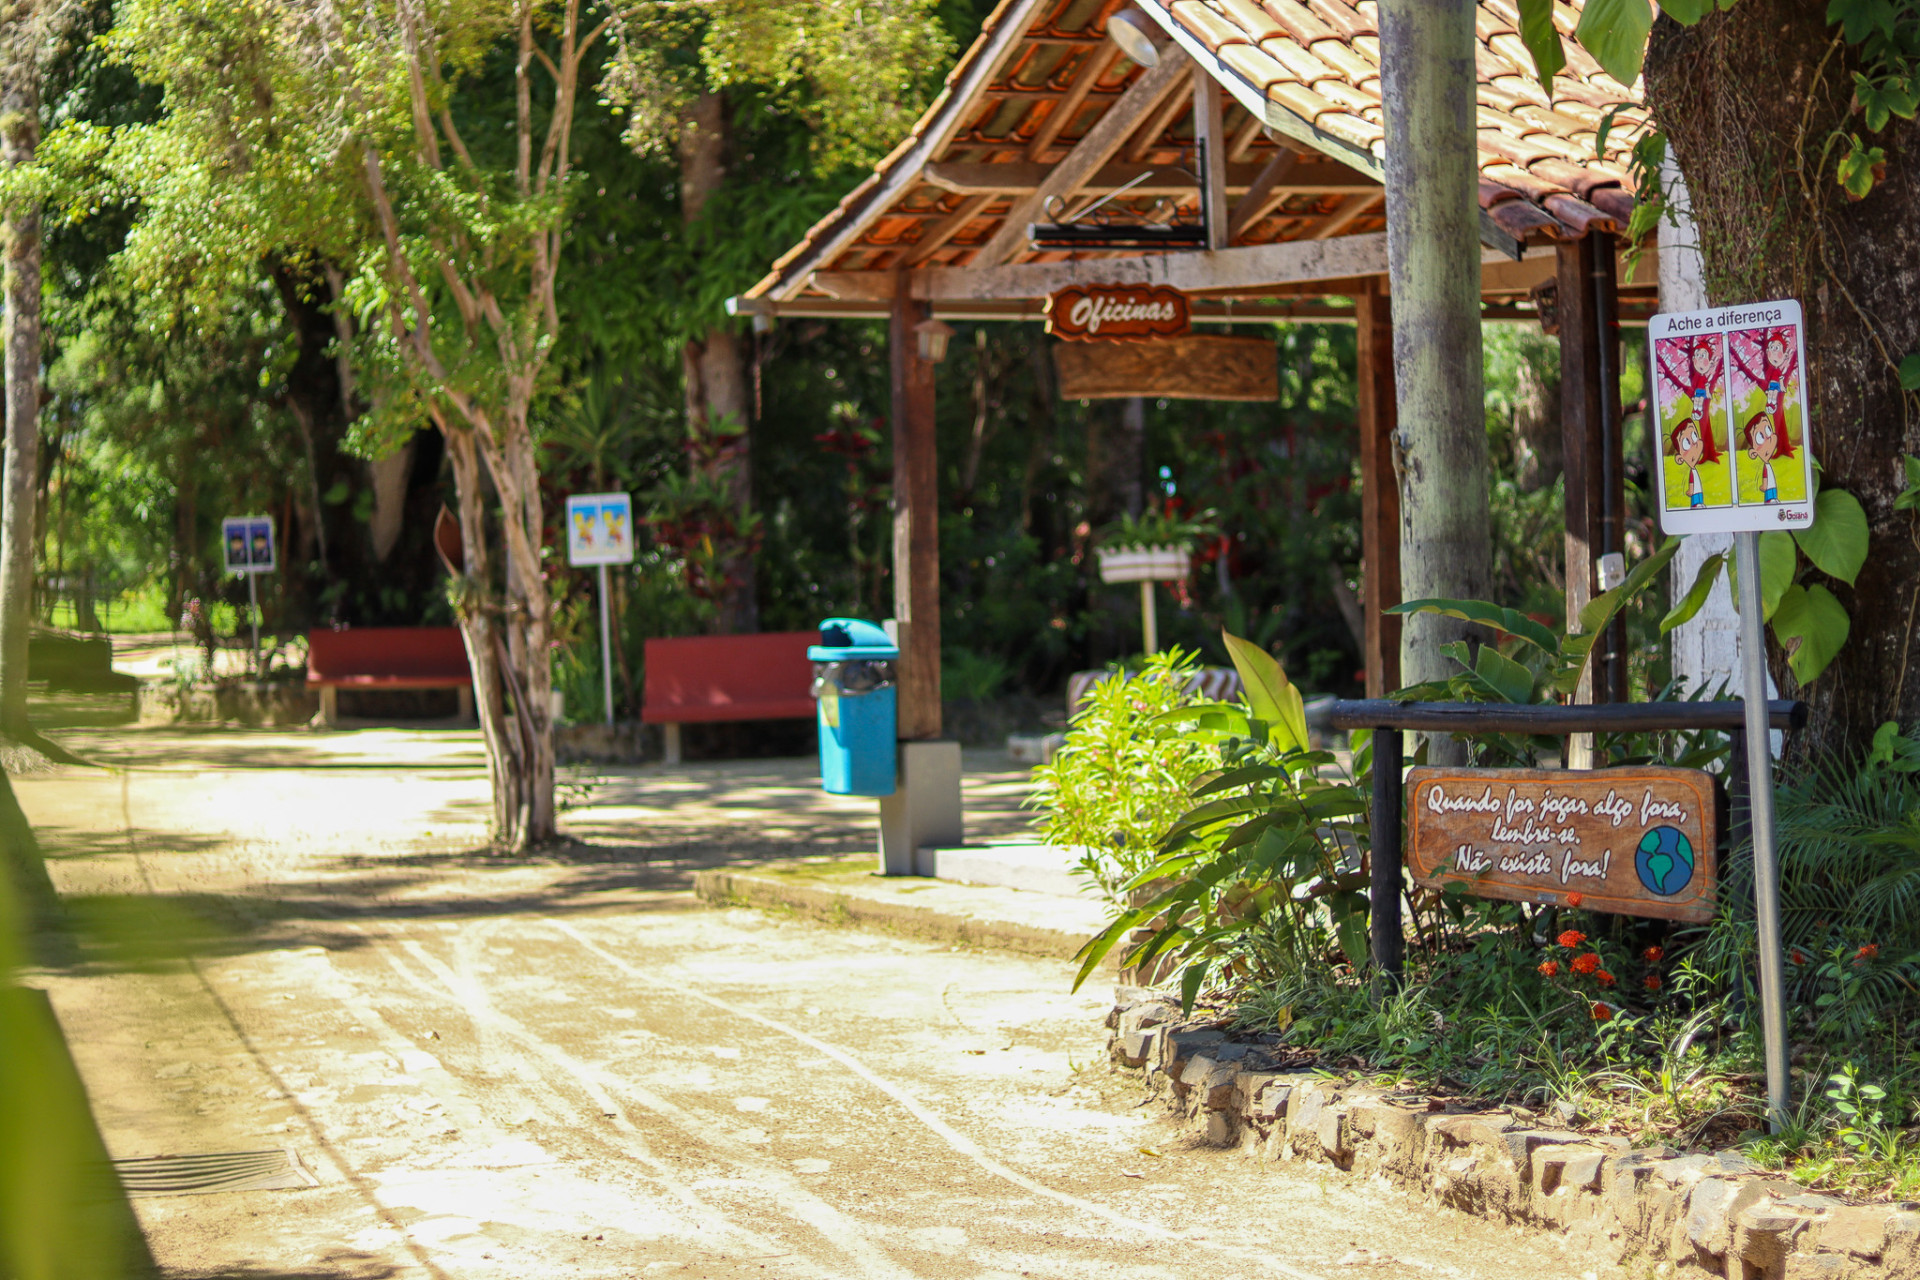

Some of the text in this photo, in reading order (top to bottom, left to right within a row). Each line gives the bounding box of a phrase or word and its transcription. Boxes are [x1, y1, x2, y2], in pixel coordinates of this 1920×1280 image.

[1070, 295, 1176, 334] Oficinas
[1668, 309, 1782, 332] Ache a diferença
[1427, 784, 1688, 828] Quando for jogar algo fora,
[1498, 849, 1552, 875] existe
[1560, 848, 1611, 886] fora!
